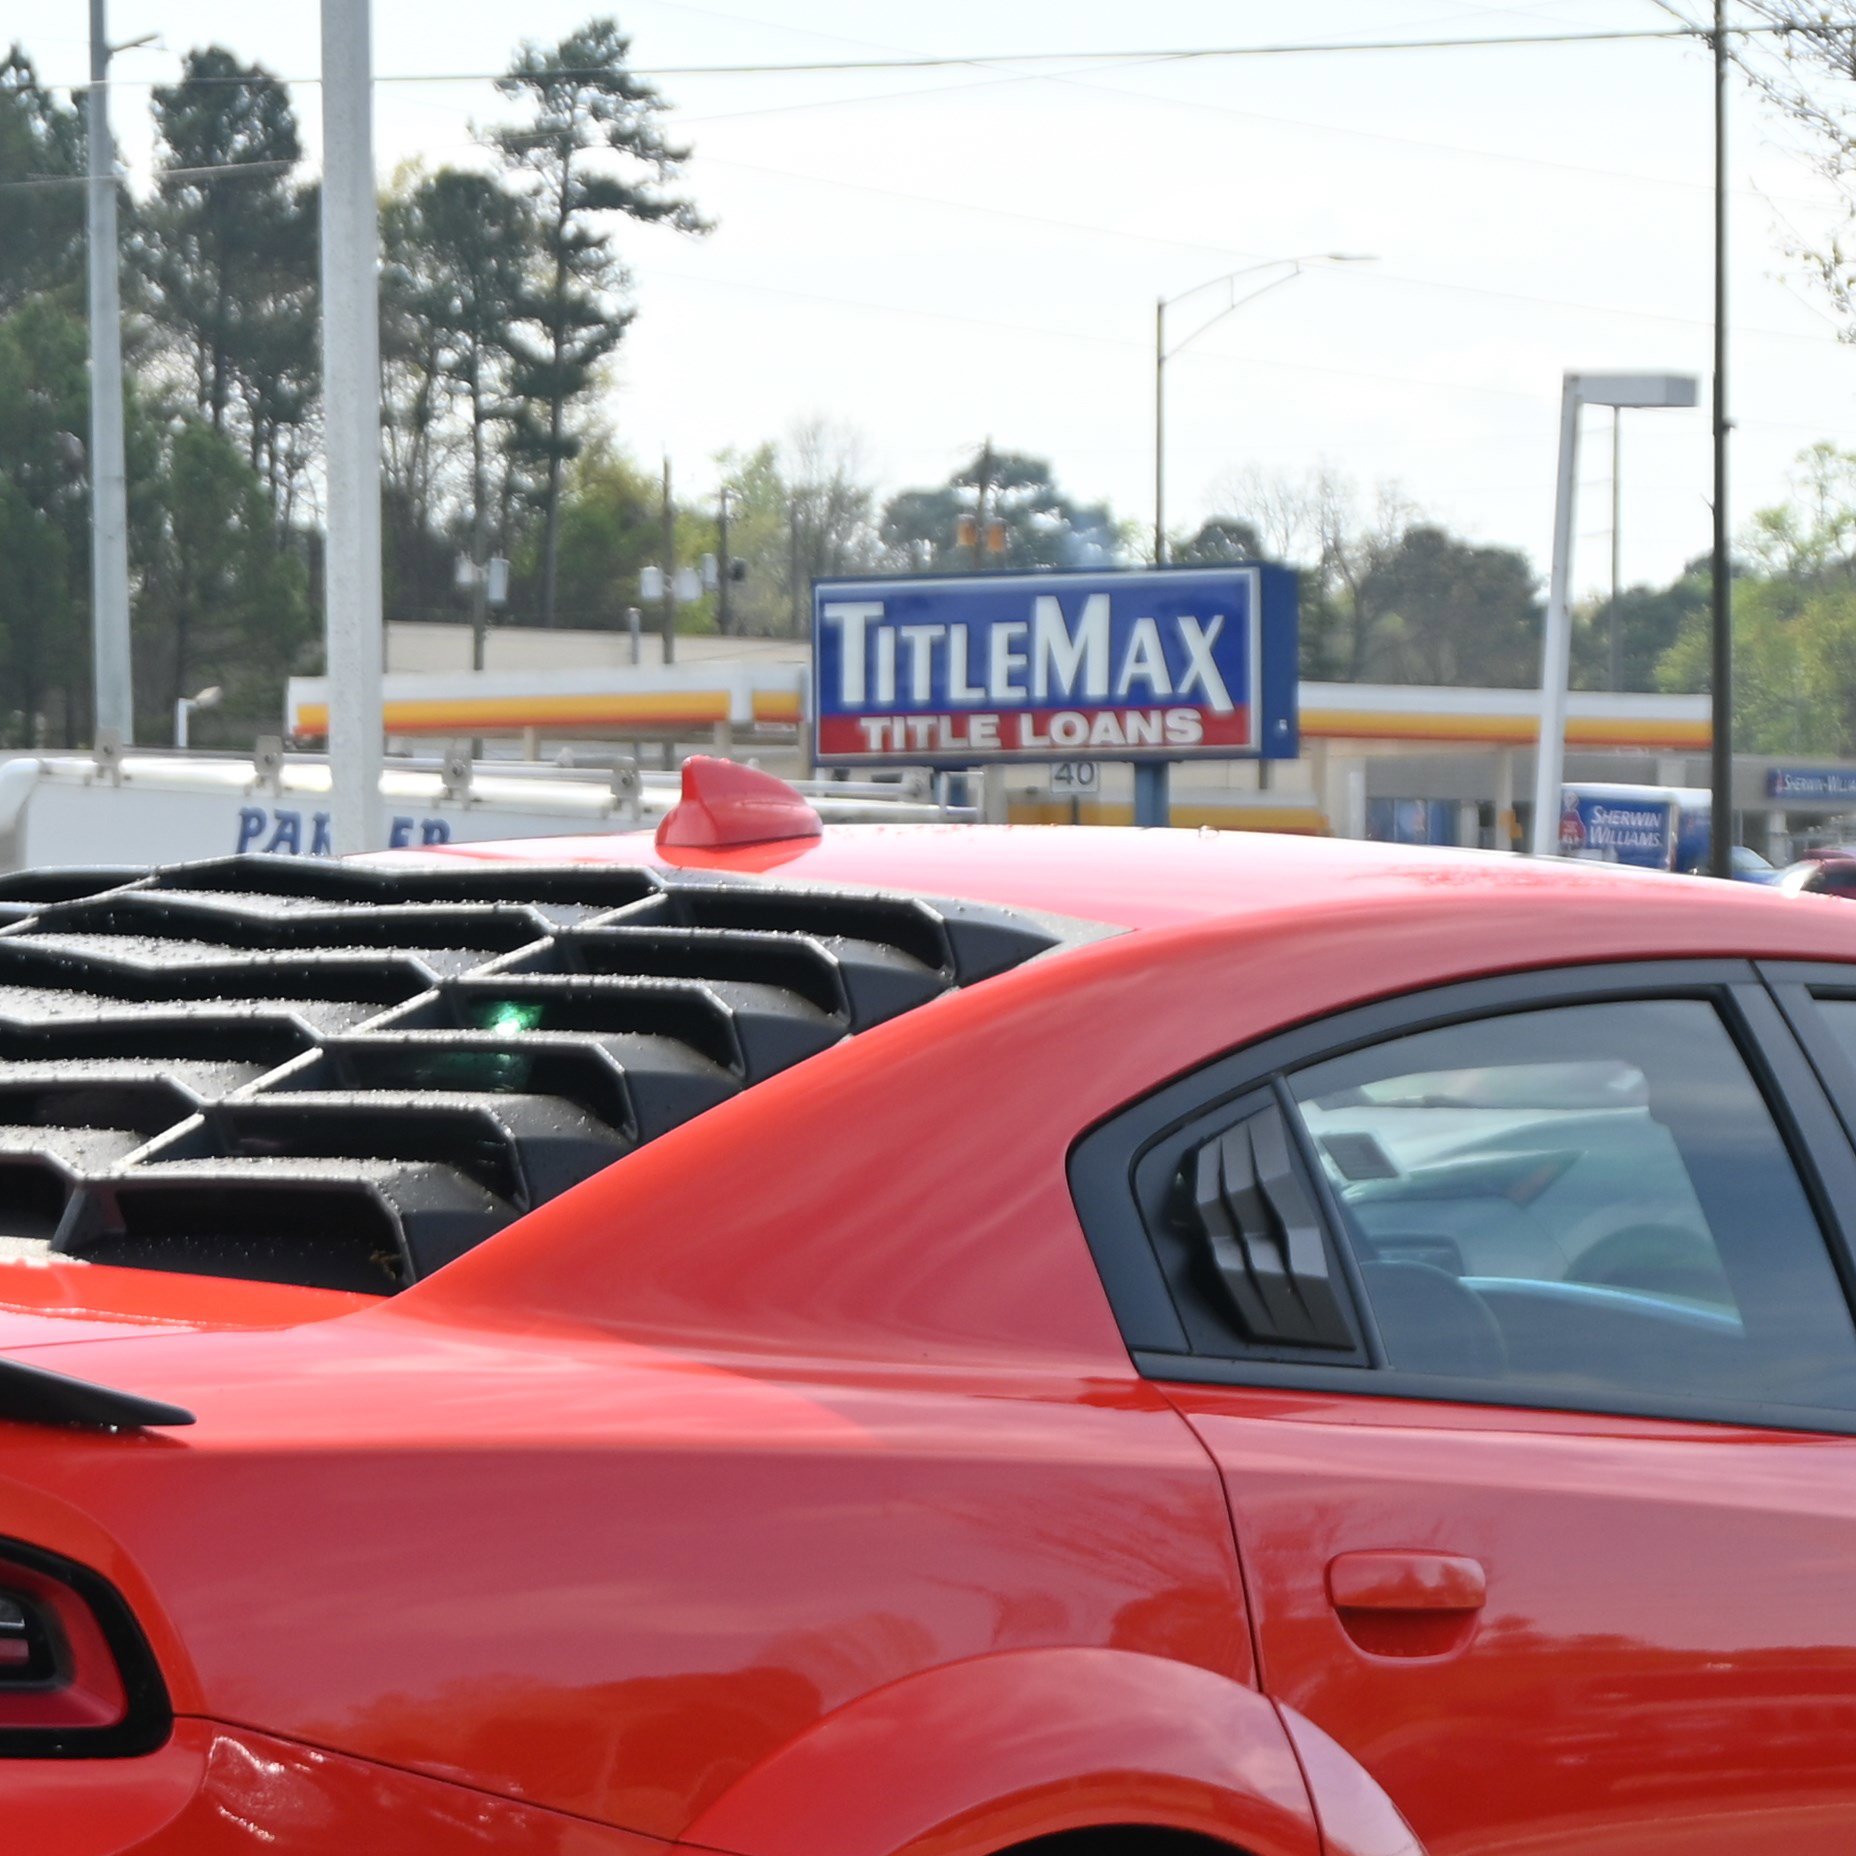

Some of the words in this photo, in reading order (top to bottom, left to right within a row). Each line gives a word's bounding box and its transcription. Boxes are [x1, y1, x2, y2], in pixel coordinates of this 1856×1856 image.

[859, 713, 1002, 751] TITLE
[1019, 708, 1204, 747] LOANS
[1053, 762, 1096, 786] 40
[1591, 805, 1662, 827] SHERWIN
[1589, 826, 1662, 848] WILLIAMS
